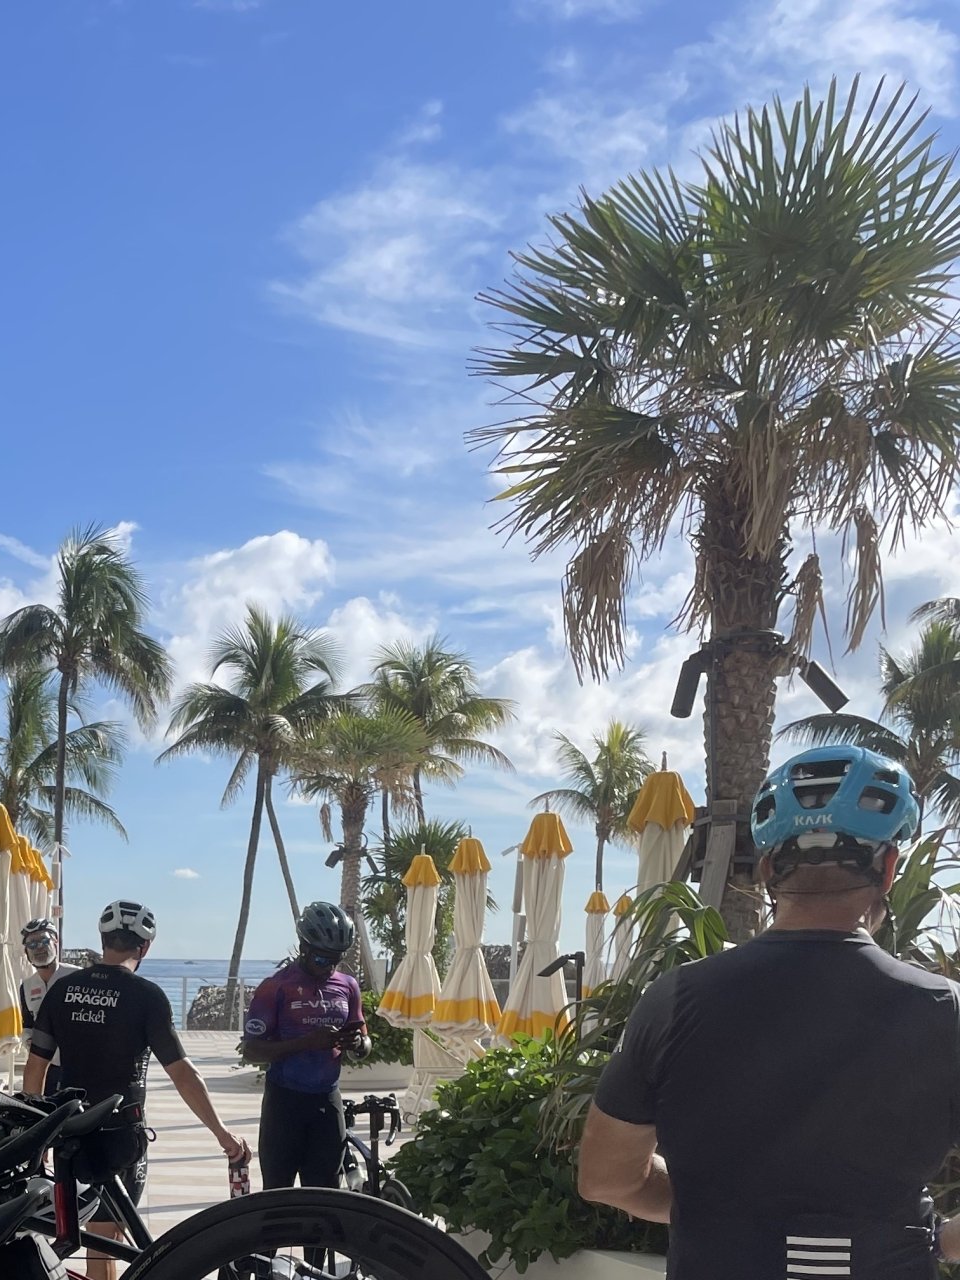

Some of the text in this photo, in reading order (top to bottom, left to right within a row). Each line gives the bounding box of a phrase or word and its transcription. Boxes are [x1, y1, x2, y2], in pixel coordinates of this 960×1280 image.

[793, 813, 833, 827] KASK
[67, 985, 121, 998] DRUNKEN
[64, 992, 119, 1008] DRAGON
